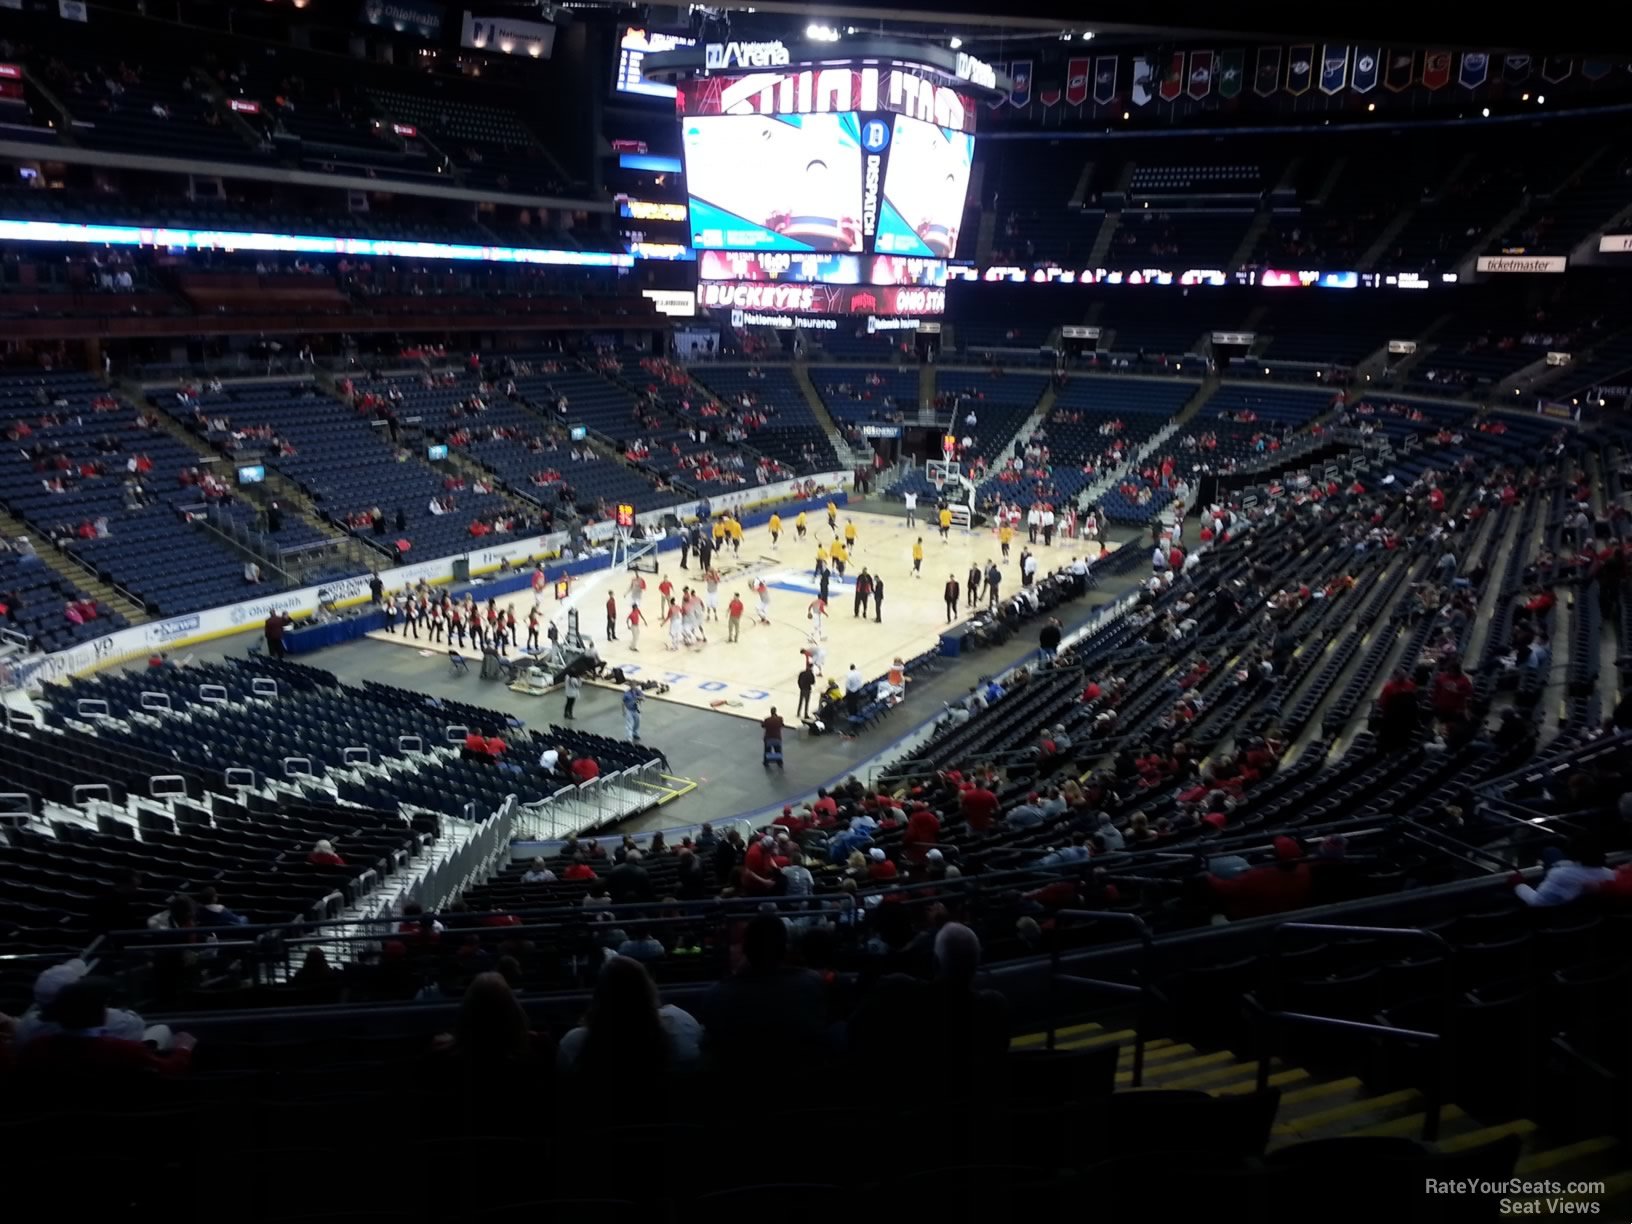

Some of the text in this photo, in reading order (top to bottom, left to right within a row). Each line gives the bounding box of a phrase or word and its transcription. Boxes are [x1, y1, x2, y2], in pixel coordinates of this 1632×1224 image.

[499, 30, 542, 42] Nationwide
[722, 42, 790, 68] Arena
[863, 154, 881, 237] DISPATCH
[1487, 259, 1551, 272] ticketmaster
[705, 284, 815, 310] BUCKEYES
[896, 291, 926, 312] OHIO
[744, 313, 837, 330] Nationwide Insurance
[249, 596, 302, 617] OhioHealth
